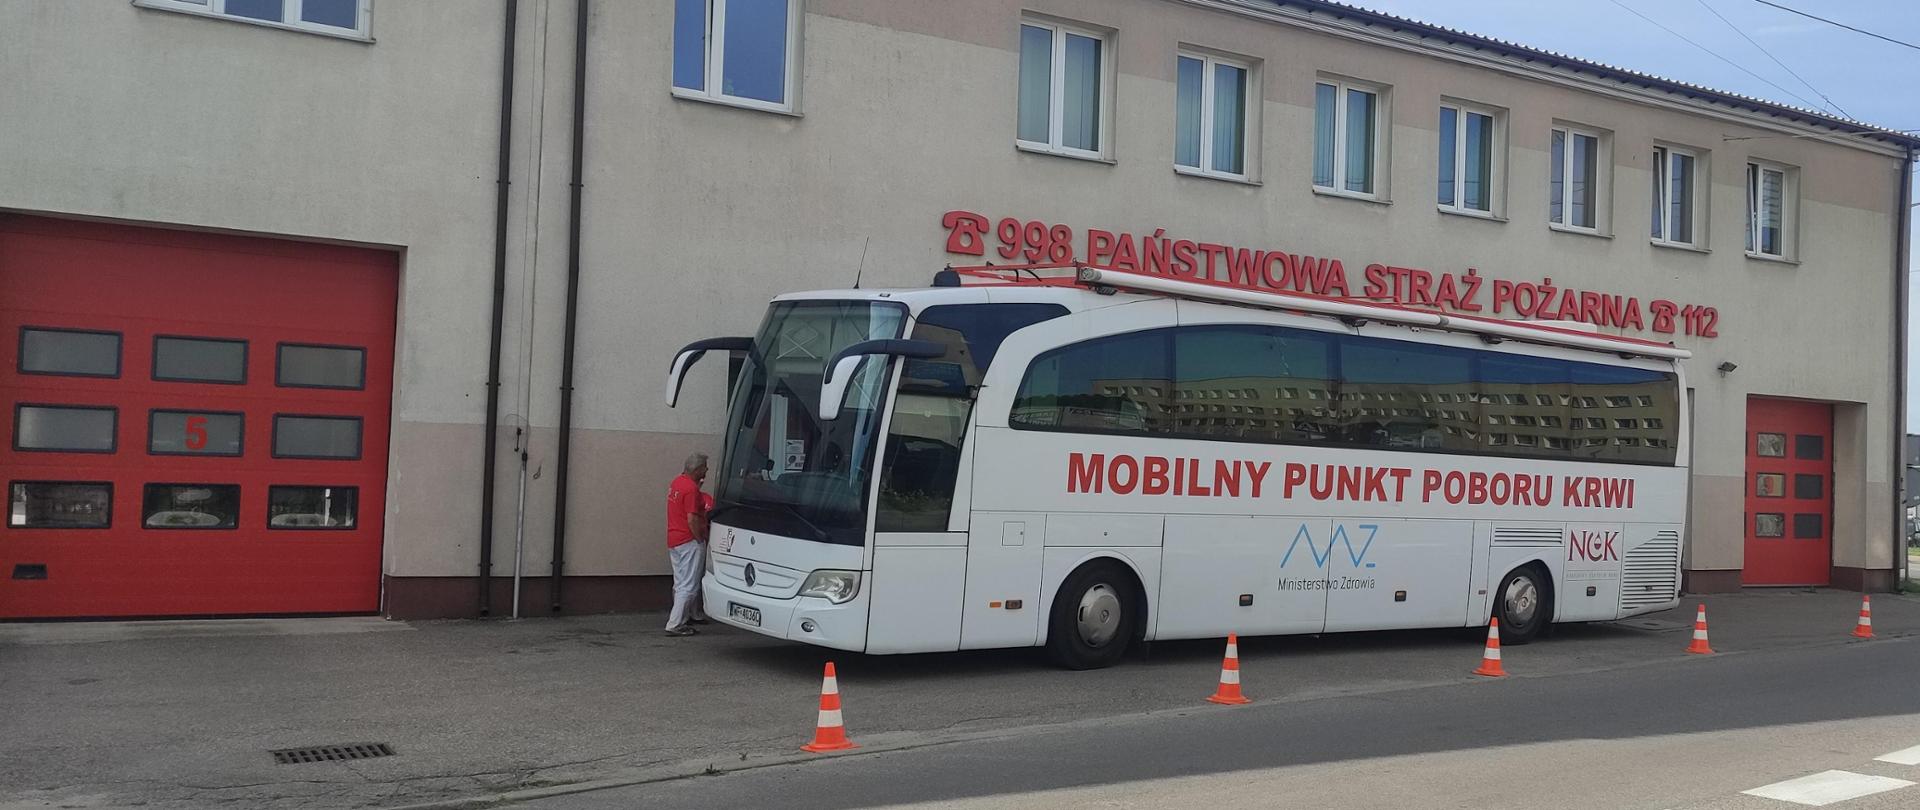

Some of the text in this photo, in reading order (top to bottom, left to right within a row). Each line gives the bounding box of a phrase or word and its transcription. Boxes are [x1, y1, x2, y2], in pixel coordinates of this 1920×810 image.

[997, 217, 1719, 338] 998 PAŃSTWOWA STRAŻ POŻARNA 112
[184, 416, 208, 450] 5
[1067, 452, 1635, 509] MOBILNY PUNKT POBORU KRWI
[1278, 576, 1375, 591] Ministerstwo Zdrowia
